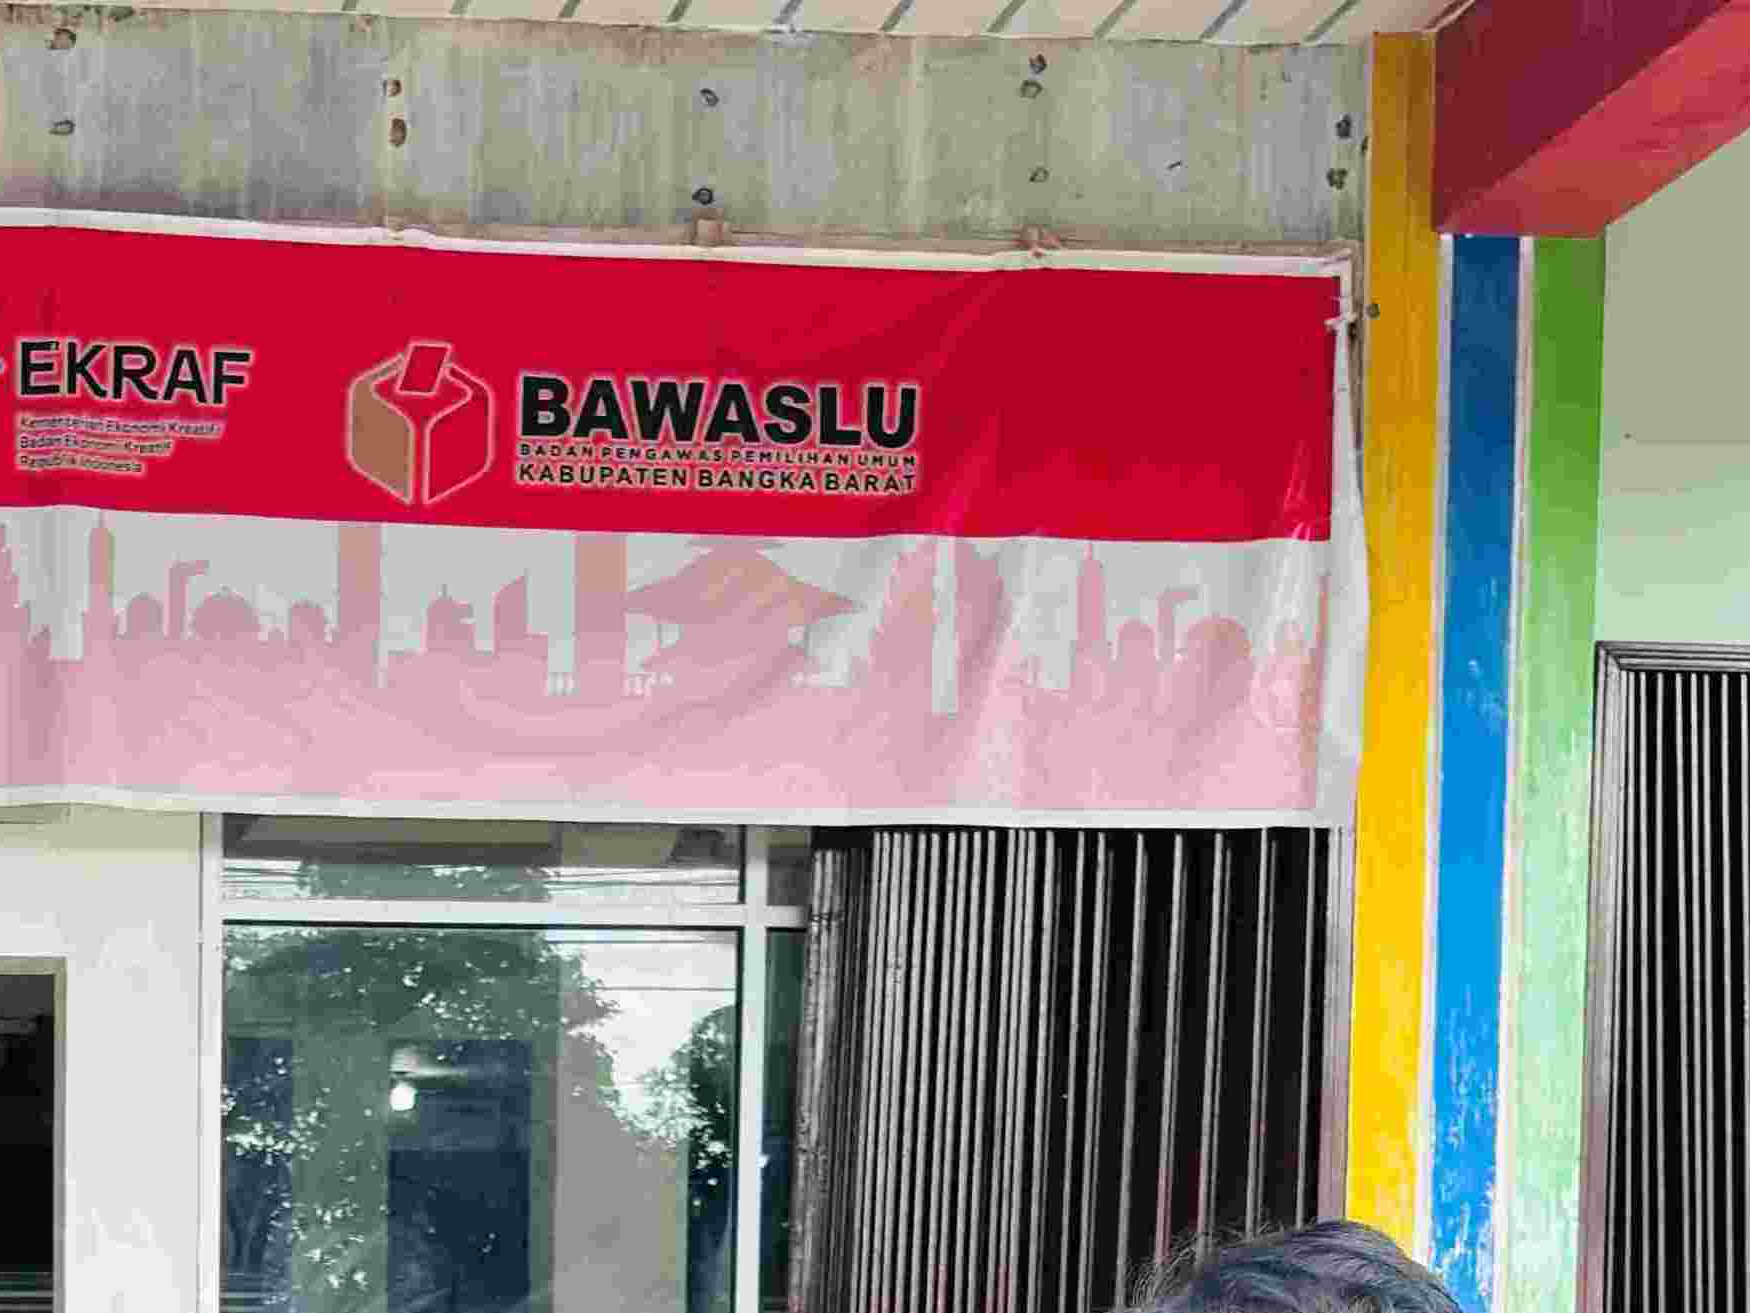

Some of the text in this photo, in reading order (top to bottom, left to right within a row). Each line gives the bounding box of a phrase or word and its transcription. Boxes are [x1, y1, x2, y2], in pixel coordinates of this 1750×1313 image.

[19, 340, 251, 405] EKRAF
[519, 374, 918, 448] BAWASLU
[518, 463, 915, 492] KABUPATEN BANGKA BARAT
[519, 443, 917, 467] BADAN PENGAWAS PEMILIHAN UMUM
